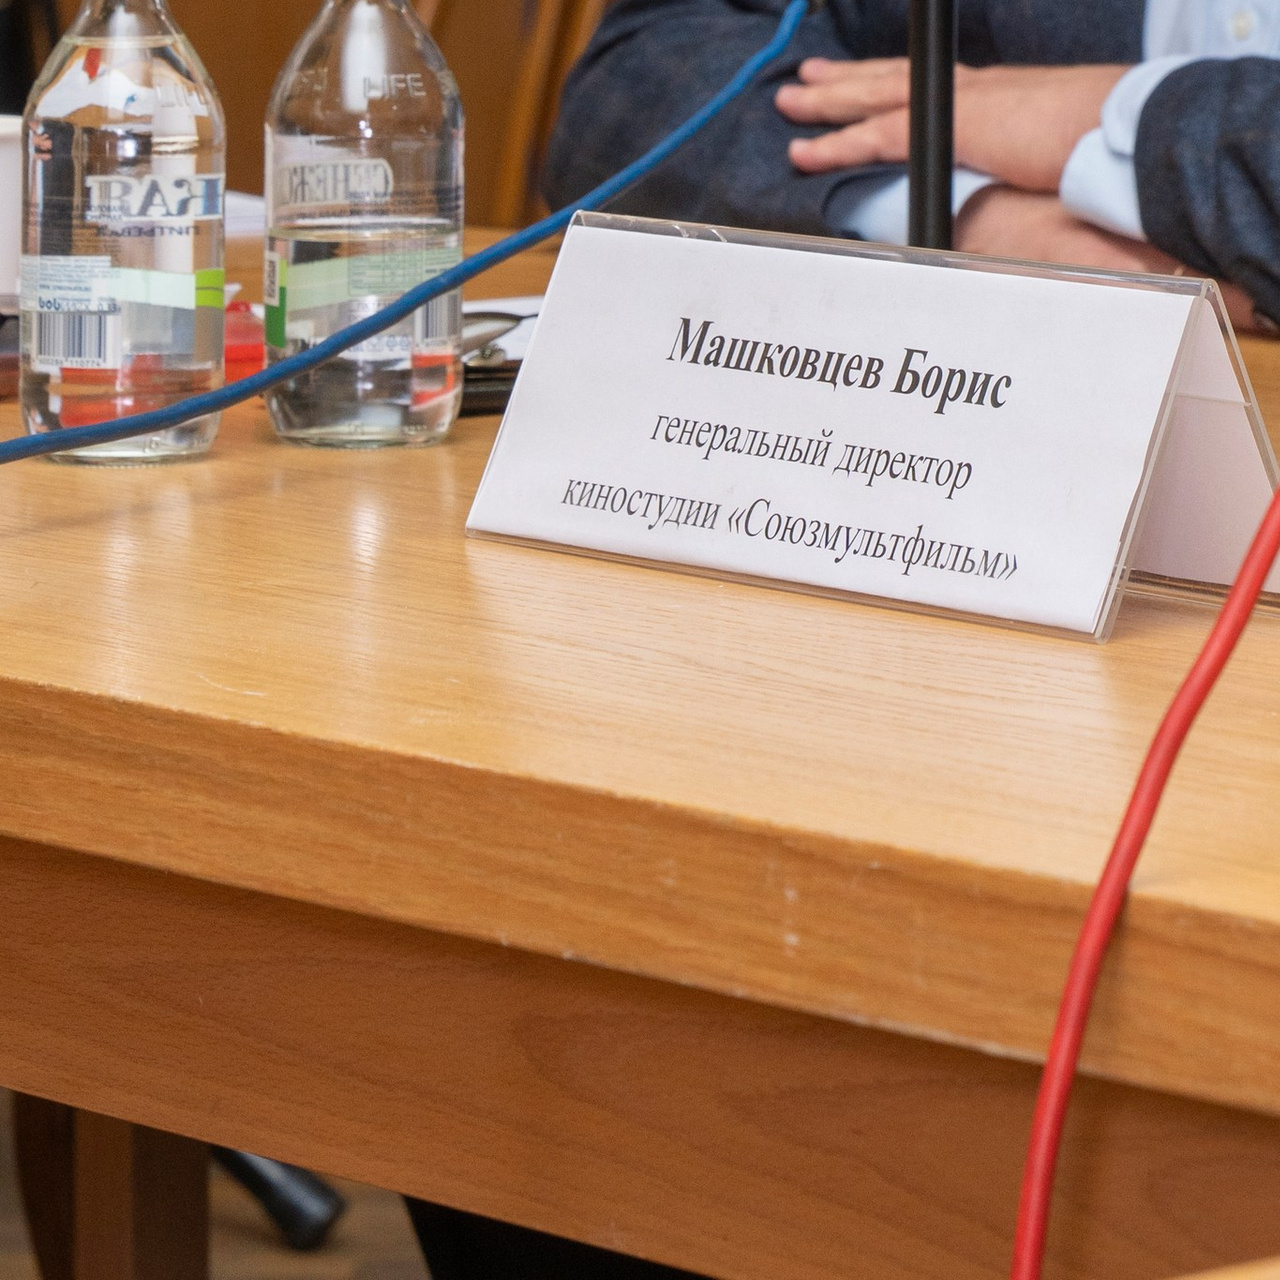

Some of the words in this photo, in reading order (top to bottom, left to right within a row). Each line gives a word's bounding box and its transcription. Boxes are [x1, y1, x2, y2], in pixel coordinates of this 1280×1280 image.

[666, 316, 885, 392] Машковцев
[889, 347, 1013, 416] Борис
[650, 414, 834, 468] генеральный
[831, 443, 973, 501] директор
[560, 478, 723, 531] киностудии
[727, 497, 1019, 581] «Союзмультфильм»
